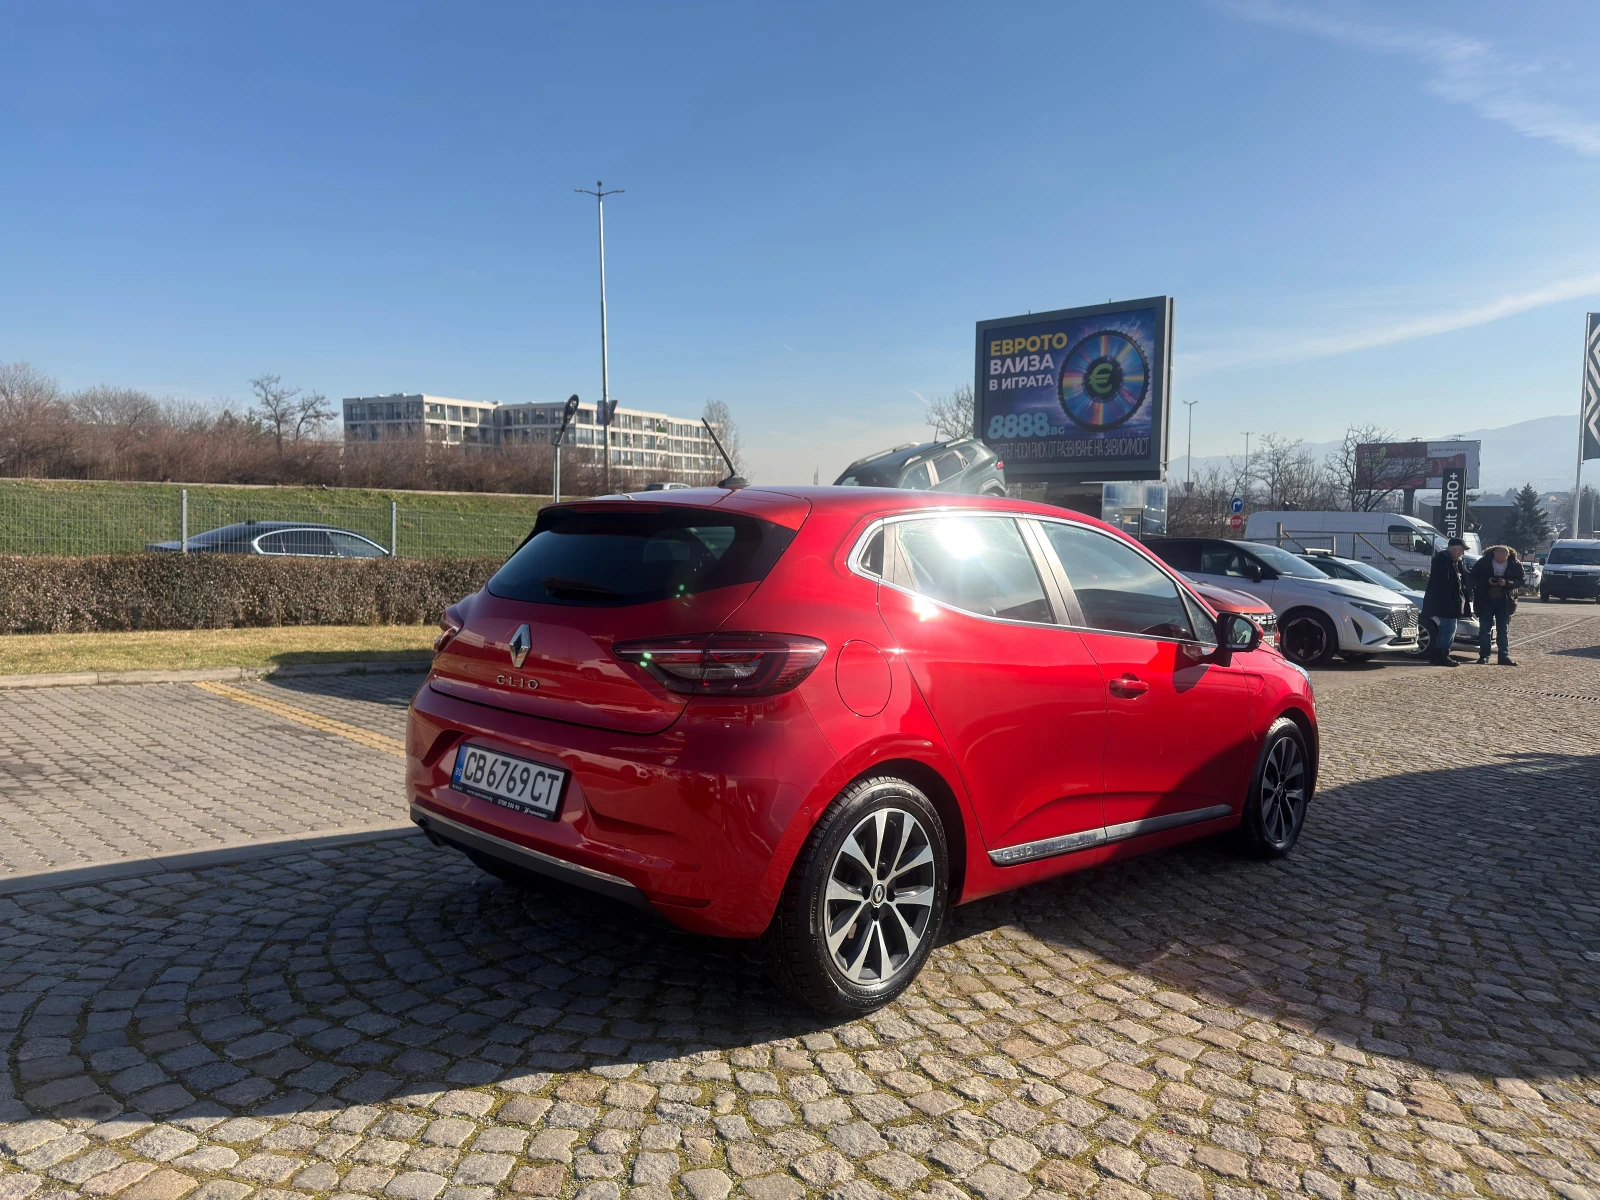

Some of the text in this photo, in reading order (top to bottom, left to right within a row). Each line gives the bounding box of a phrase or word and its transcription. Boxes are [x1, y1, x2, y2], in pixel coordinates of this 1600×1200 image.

[990, 333, 1067, 356] ЕВРОТО
[990, 354, 1054, 375] ВЛИЗА
[989, 373, 1054, 391] В ИГРАТА
[1015, 442, 1030, 458] НОСИ
[1032, 441, 1047, 458] РИСК
[1048, 441, 1056, 457] ОТ
[1057, 440, 1093, 457] РАЗВИВАНЕ
[1095, 439, 1103, 456] НА
[1104, 438, 1149, 456] ЗАВИСИМОСТ
[1445, 472, 1459, 538] ault PRO+
[496, 675, 540, 690] CLIO
